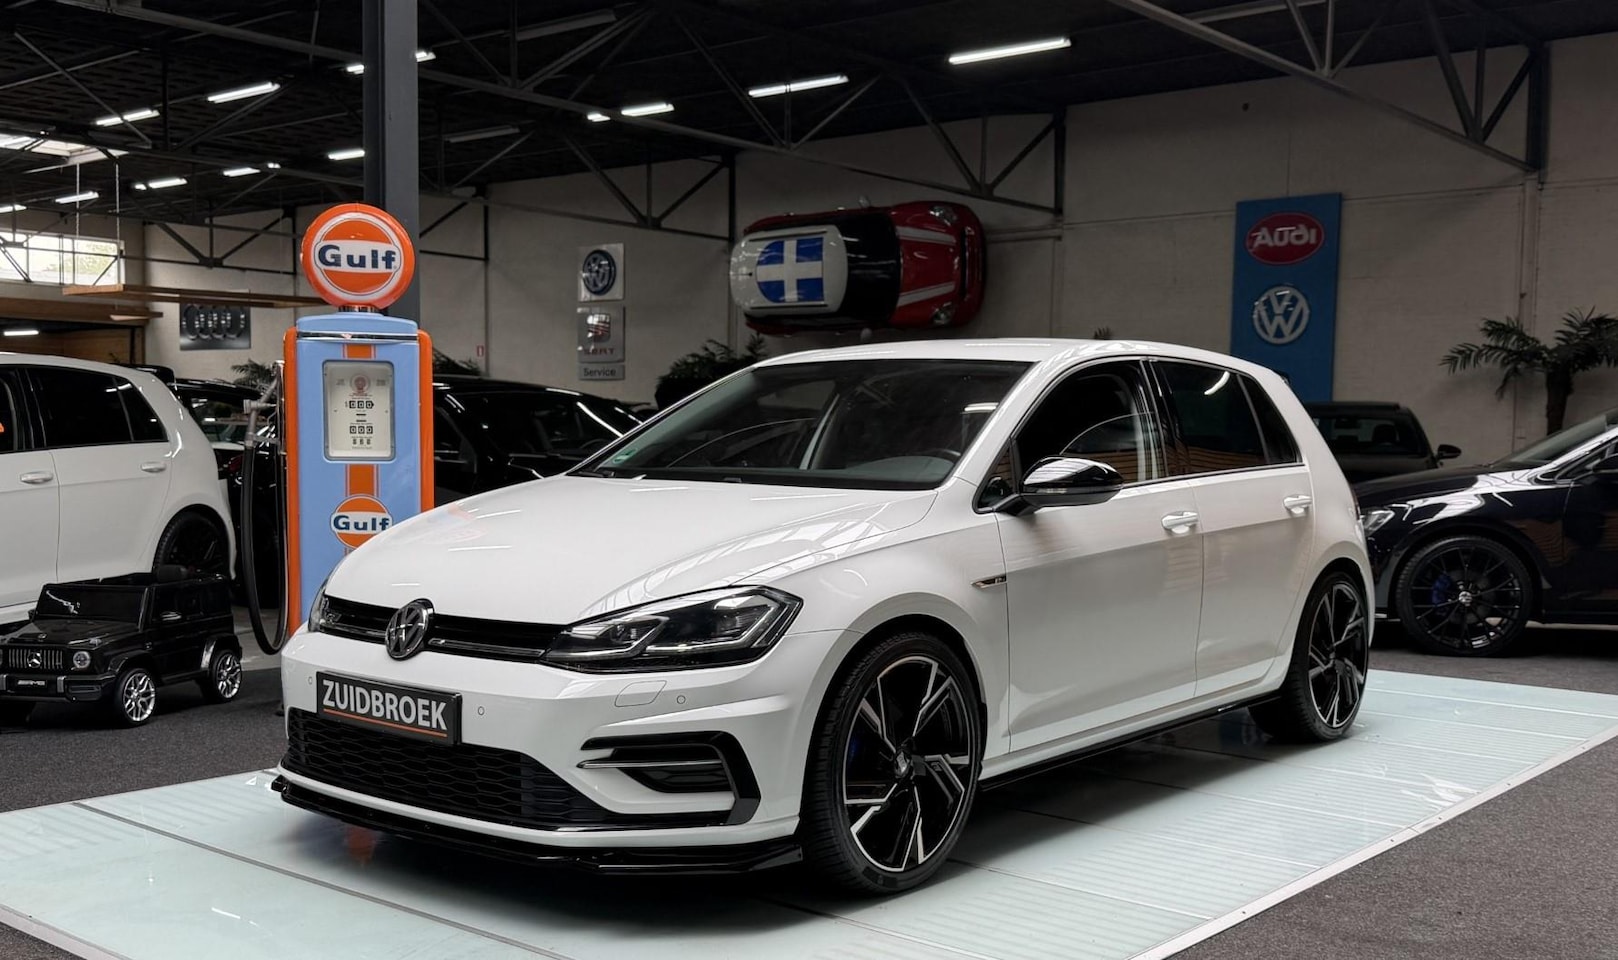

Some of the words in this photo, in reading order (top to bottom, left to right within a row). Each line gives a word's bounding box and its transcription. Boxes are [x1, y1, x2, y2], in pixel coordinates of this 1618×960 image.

[318, 244, 396, 270] Gulf
[583, 367, 616, 377] Service
[333, 514, 390, 531] Gulf
[322, 679, 448, 731] ZUIDBROEK
